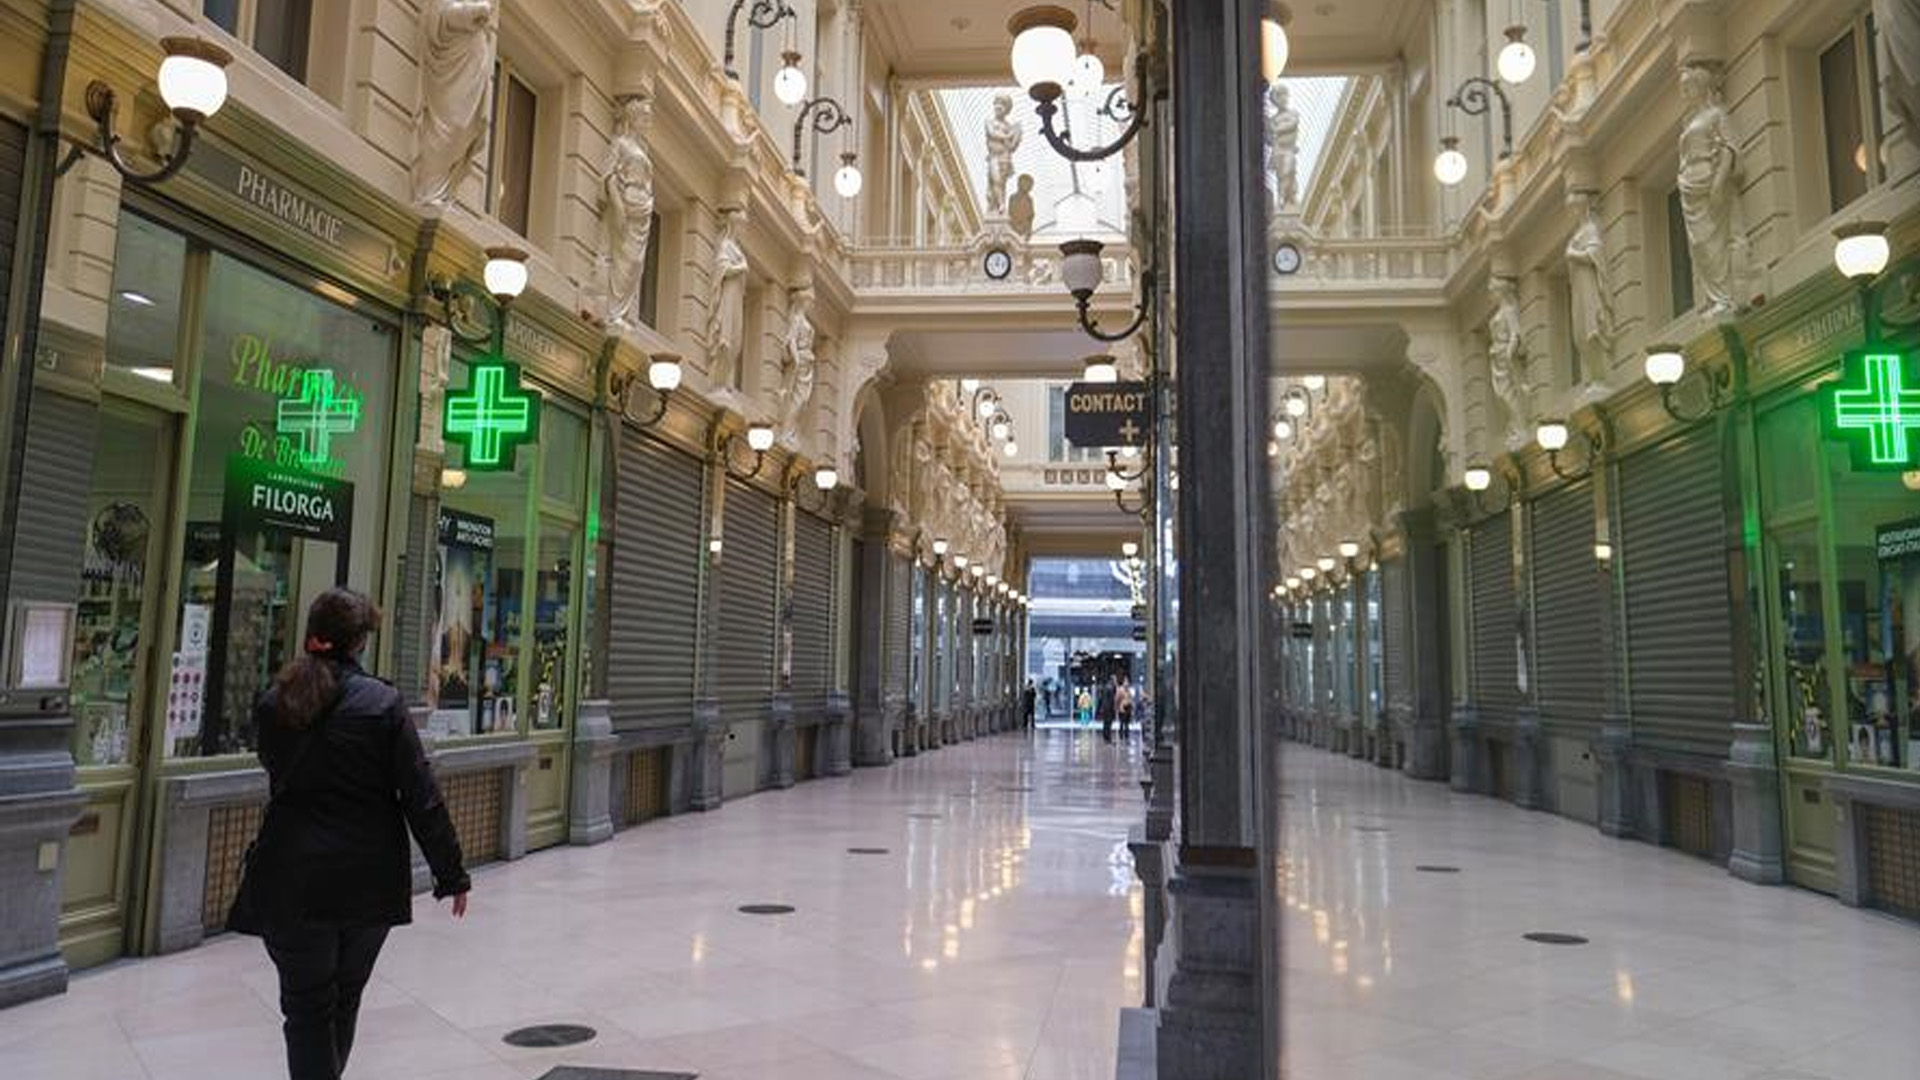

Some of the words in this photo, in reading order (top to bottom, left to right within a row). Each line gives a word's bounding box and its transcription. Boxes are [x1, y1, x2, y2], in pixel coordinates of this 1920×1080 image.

[238, 166, 343, 243] PHARMACIE
[1070, 393, 1145, 412] CONTACT
[252, 484, 334, 522] FILORGA
